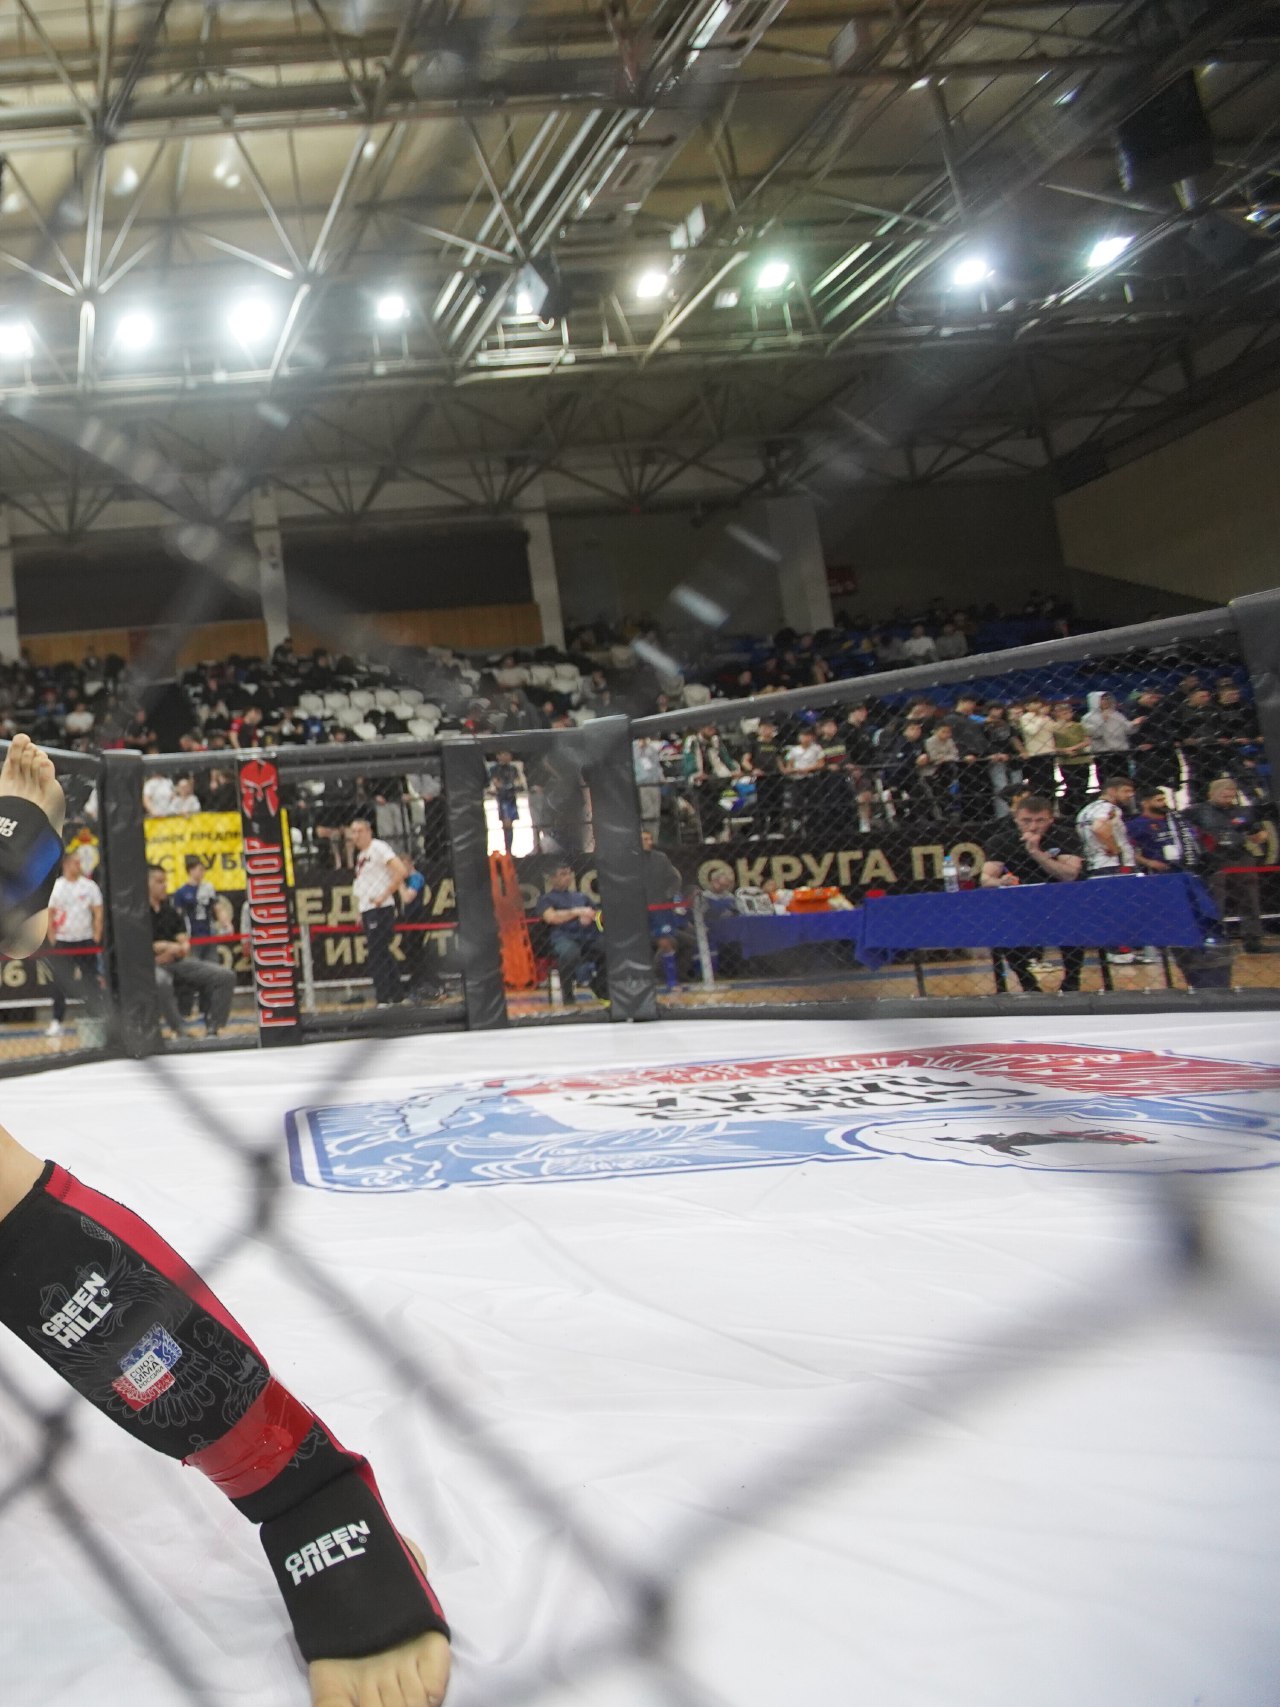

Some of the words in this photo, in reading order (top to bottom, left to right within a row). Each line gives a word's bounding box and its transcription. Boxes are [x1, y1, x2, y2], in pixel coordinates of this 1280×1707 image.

[698, 849, 898, 891] ОКРУГА
[910, 842, 987, 882] ПО
[42, 1272, 106, 1336] GREEN
[54, 1302, 113, 1349] HILL
[130, 1355, 155, 1379] СОЮЗ
[133, 1361, 160, 1385] ММА
[138, 1366, 164, 1389] РОССИИ
[285, 1520, 370, 1572] GREEN
[291, 1542, 366, 1586] HILL
